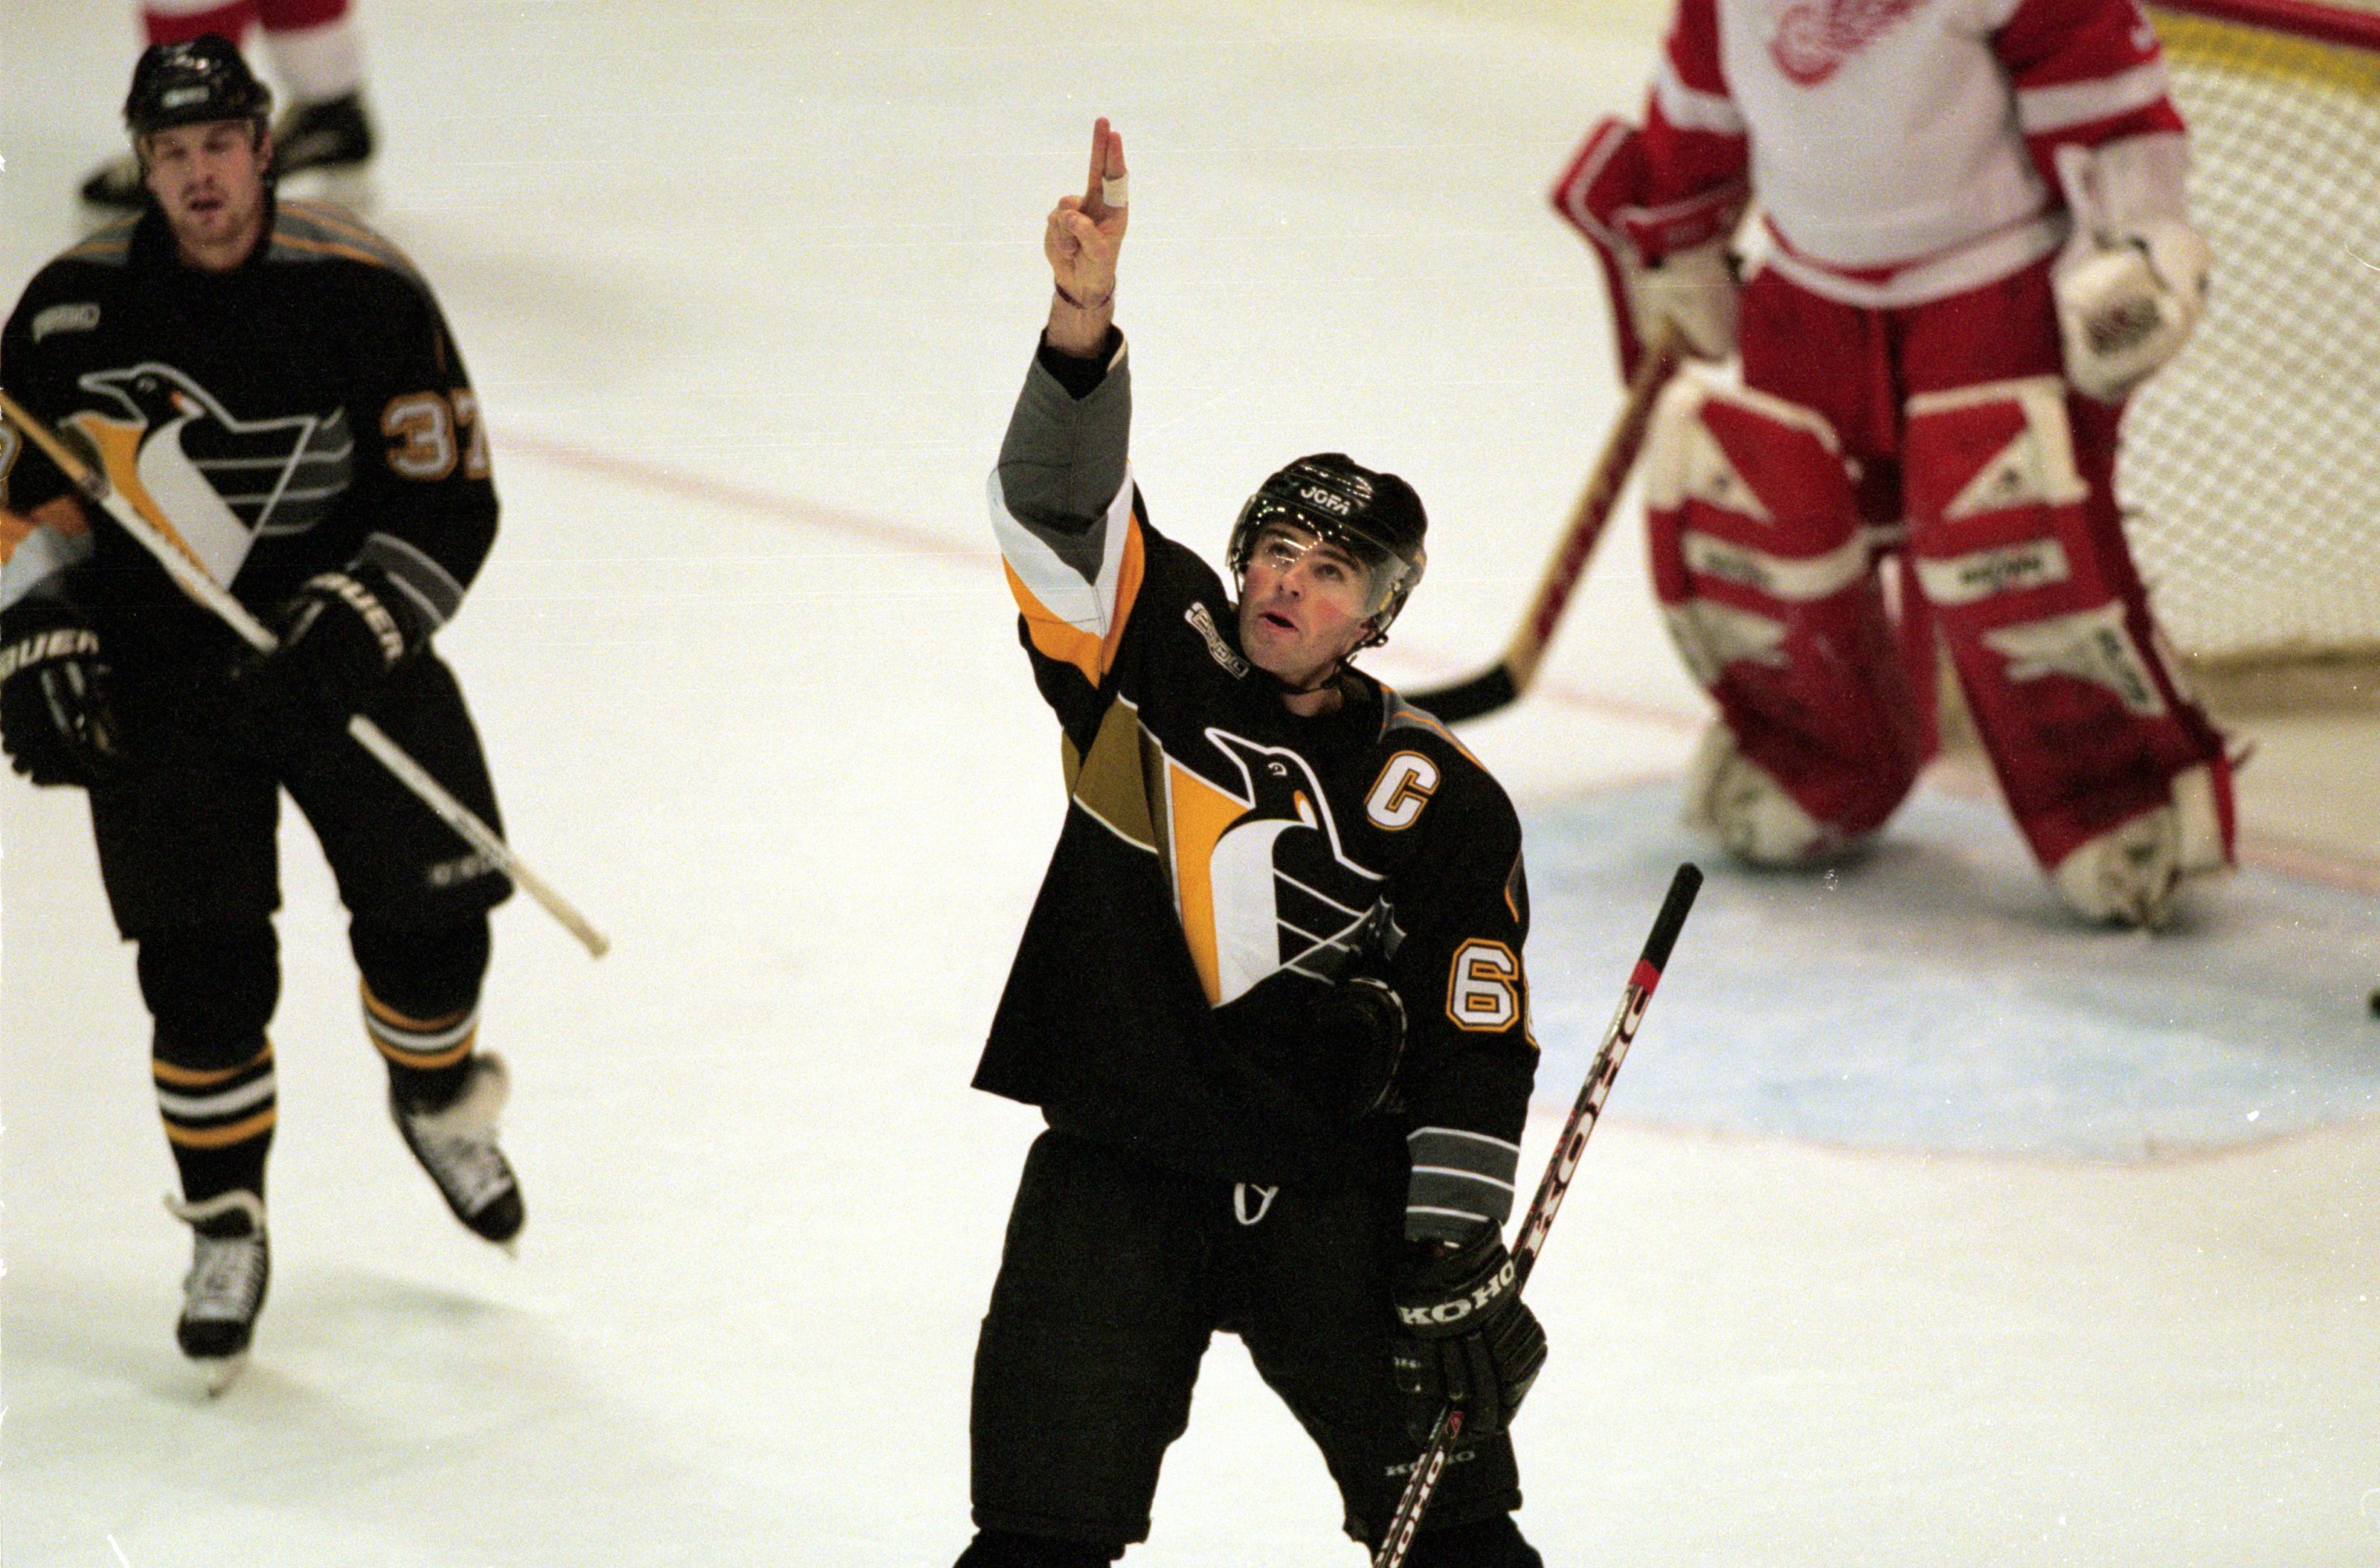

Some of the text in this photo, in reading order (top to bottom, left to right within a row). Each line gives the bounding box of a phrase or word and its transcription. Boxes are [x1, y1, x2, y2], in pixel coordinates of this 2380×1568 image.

[1299, 486, 1351, 515] JOFA
[1364, 750, 1441, 831] C
[1445, 937, 1538, 1050] 6
[1399, 1260, 1515, 1325] KOHO
